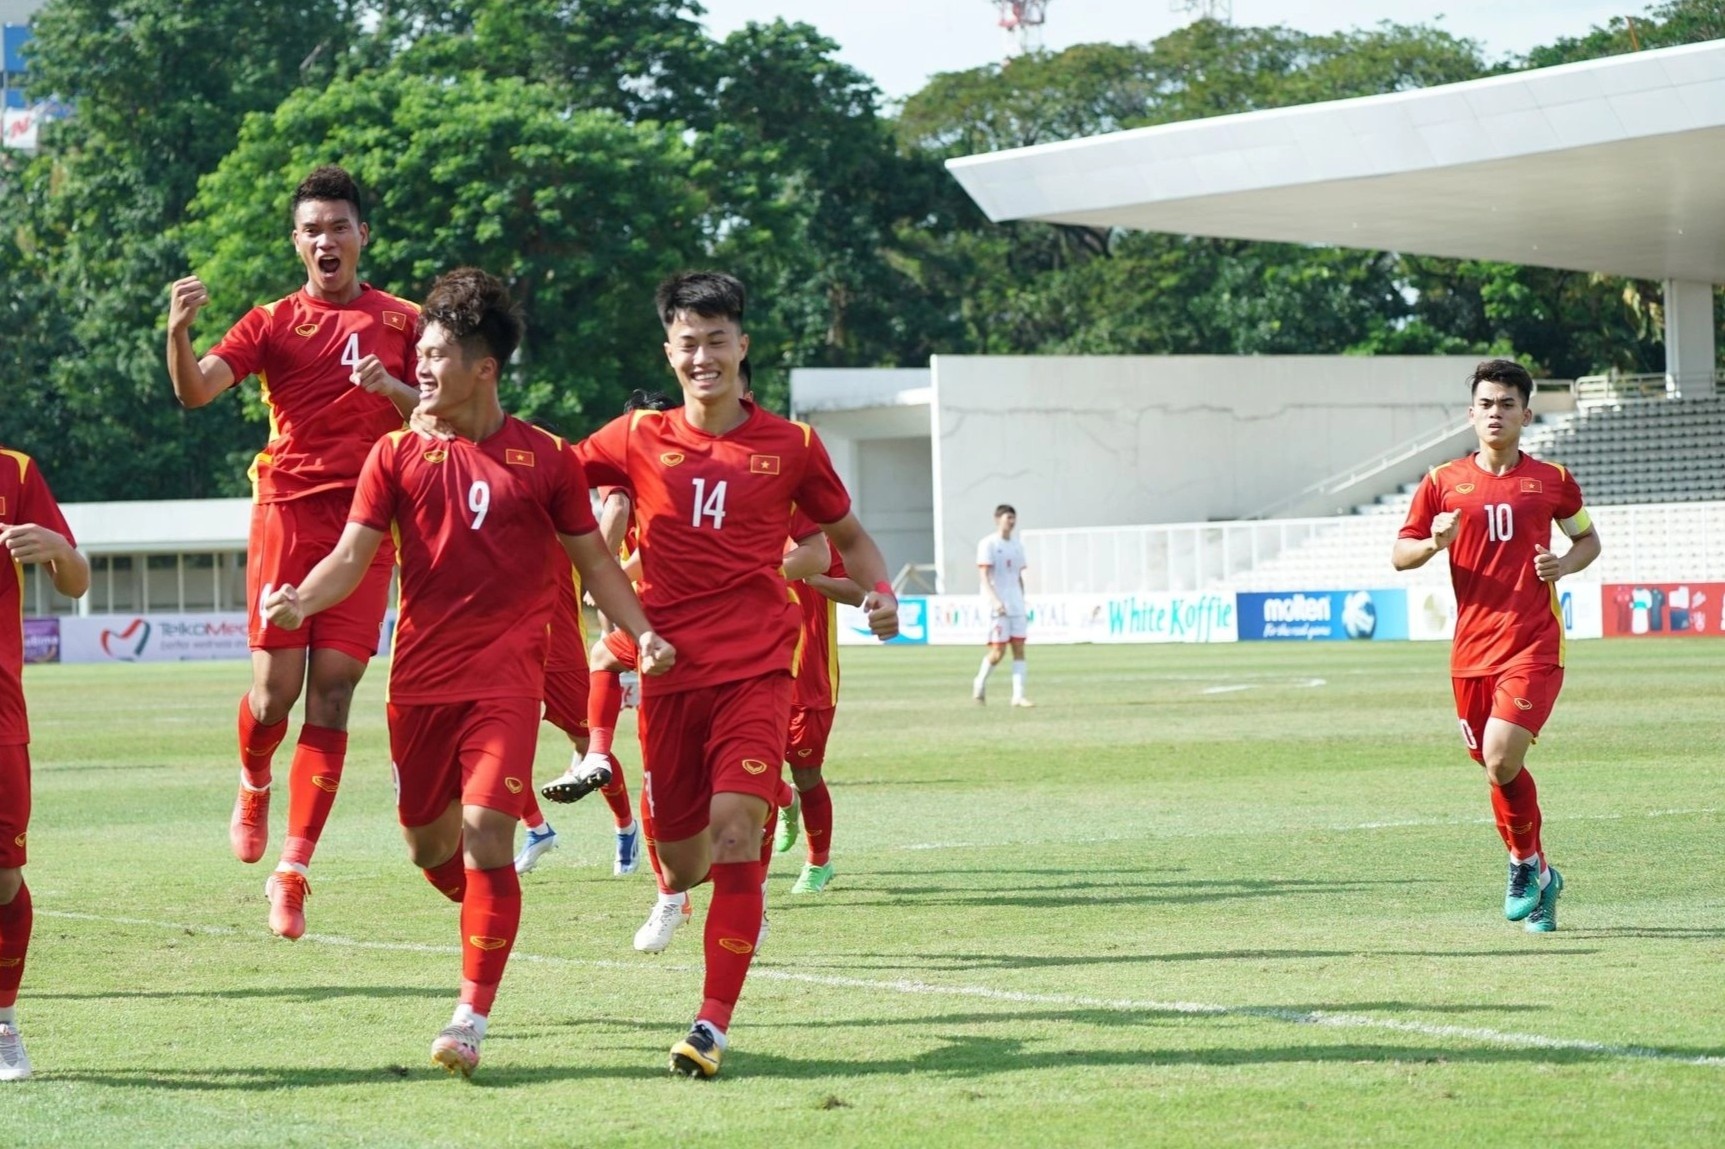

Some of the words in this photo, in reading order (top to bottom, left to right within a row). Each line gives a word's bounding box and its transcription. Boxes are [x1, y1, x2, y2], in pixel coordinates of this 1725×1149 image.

[340, 332, 361, 368] 4
[468, 480, 490, 531] 9
[691, 477, 728, 531] 14
[1484, 503, 1514, 542] 10
[934, 603, 984, 627] ROYA
[1108, 596, 1166, 635] White
[1169, 594, 1233, 643] Koffie
[1263, 593, 1332, 622] molten
